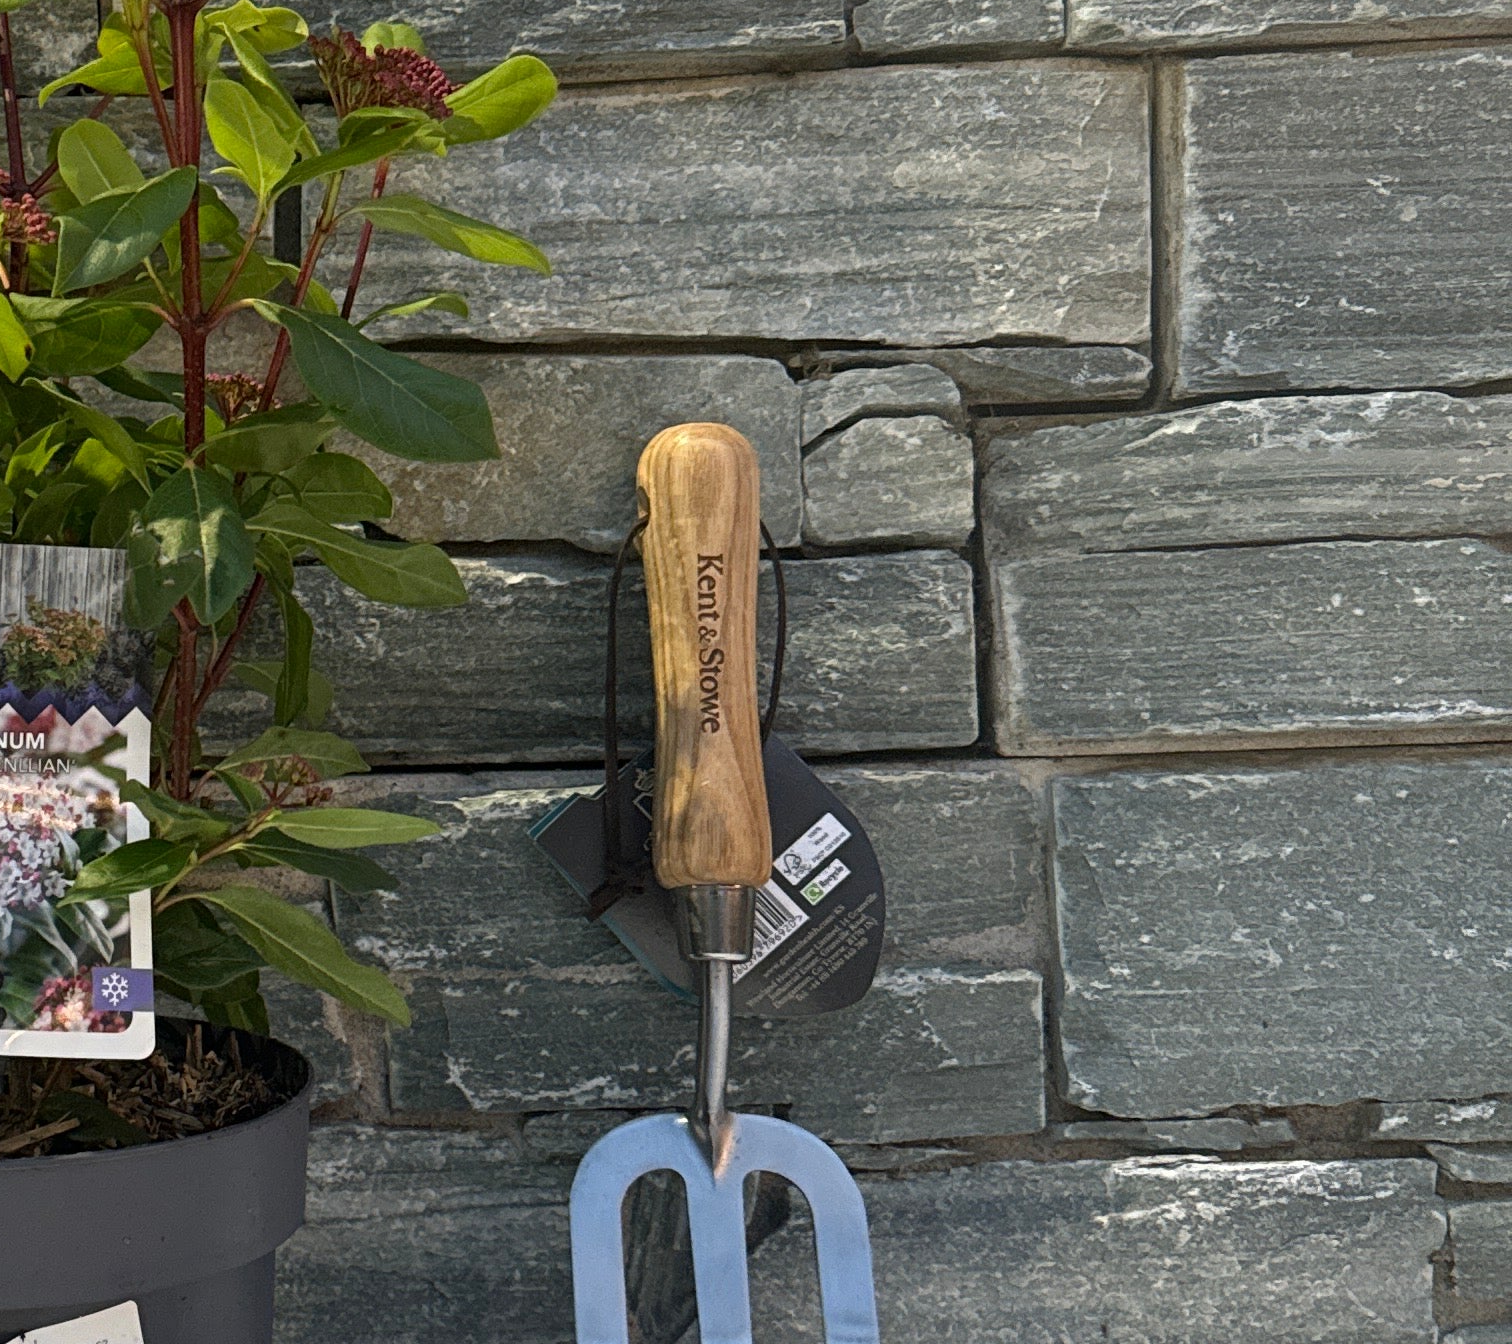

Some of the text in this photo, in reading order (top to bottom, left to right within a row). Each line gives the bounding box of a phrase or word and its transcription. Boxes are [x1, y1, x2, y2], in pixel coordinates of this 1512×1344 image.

[697, 553, 725, 735] Kent & Stowe
